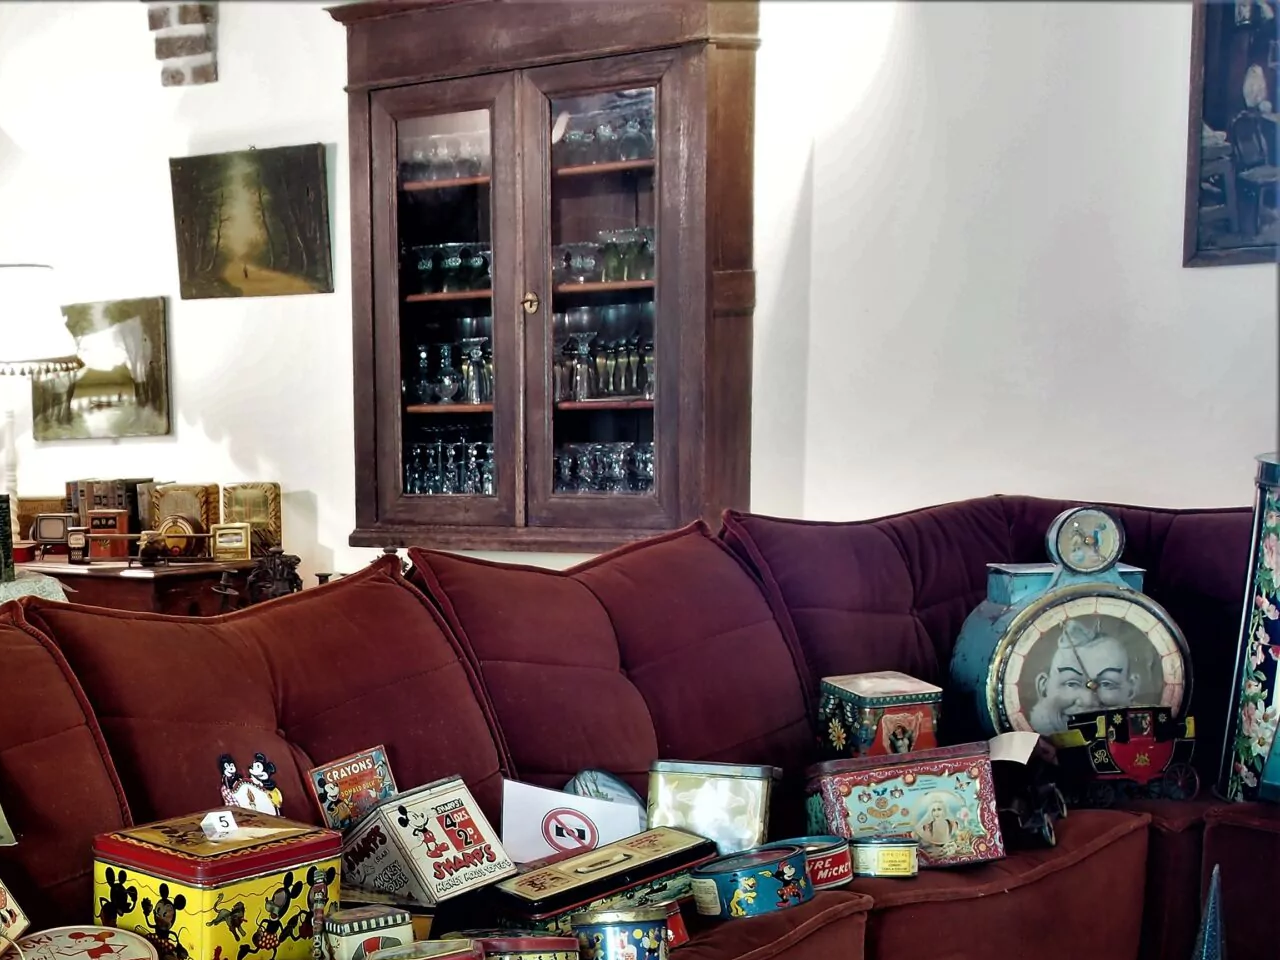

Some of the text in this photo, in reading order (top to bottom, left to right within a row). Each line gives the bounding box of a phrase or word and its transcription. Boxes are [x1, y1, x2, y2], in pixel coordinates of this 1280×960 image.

[326, 758, 373, 782] CRAYONS
[219, 815, 230, 828] 5
[443, 813, 457, 830] 4
